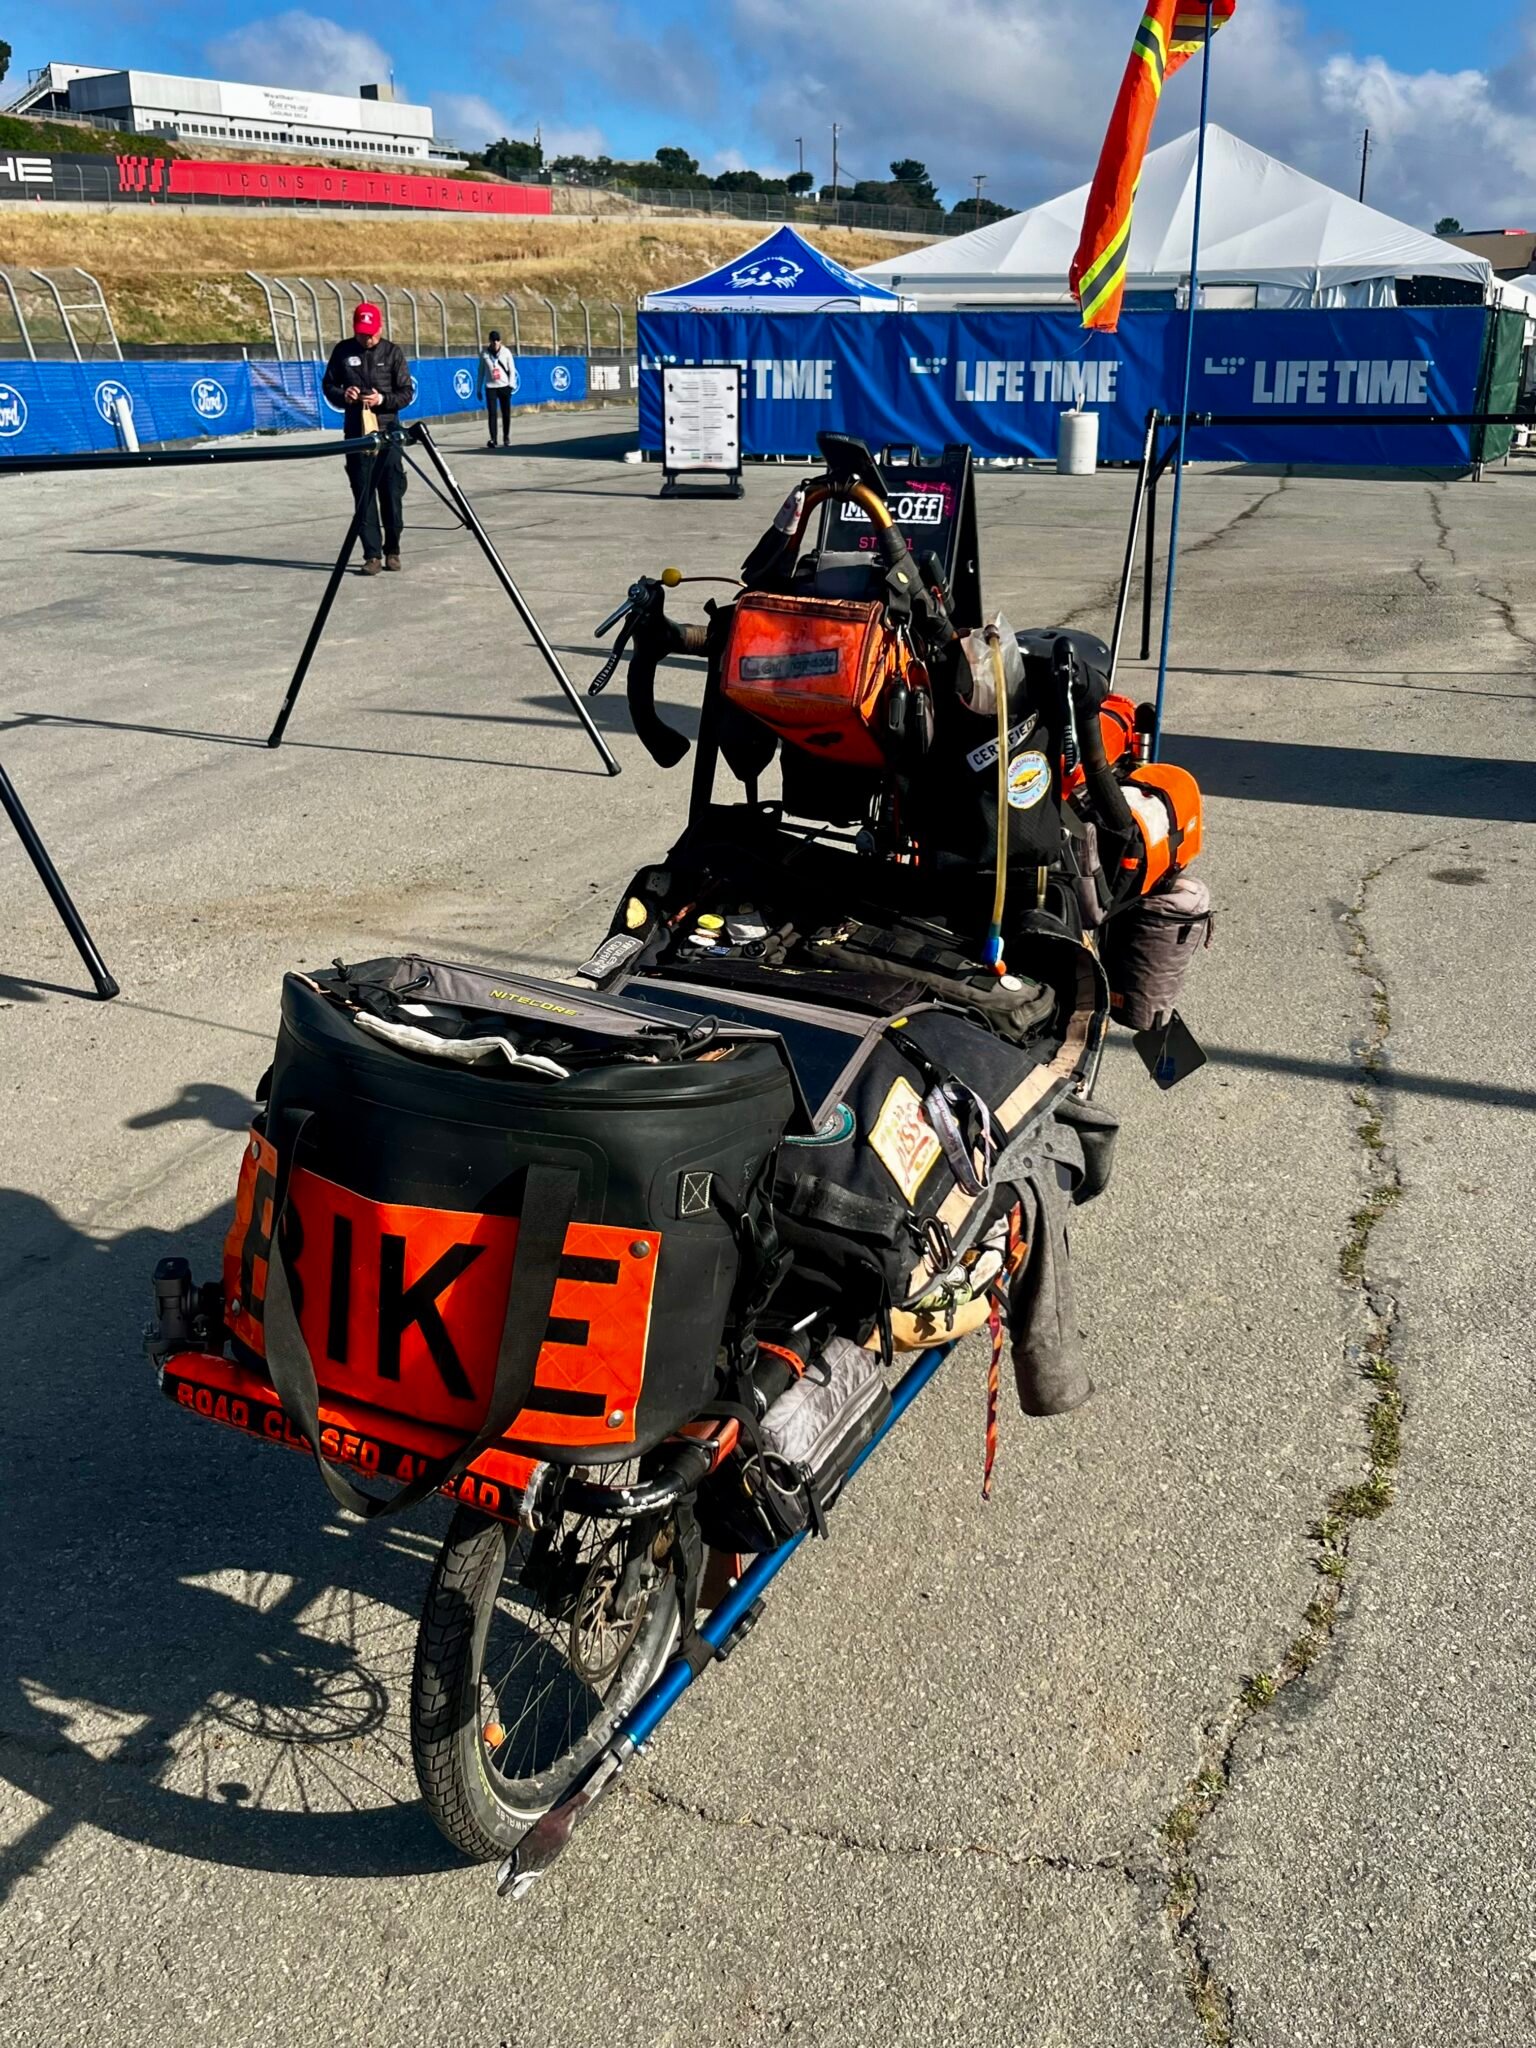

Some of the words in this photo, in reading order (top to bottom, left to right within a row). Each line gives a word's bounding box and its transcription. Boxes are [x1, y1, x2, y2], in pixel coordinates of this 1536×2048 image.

[225, 172, 305, 190] ICONS
[323, 177, 348, 192] OF
[367, 180, 408, 198] THE
[425, 185, 495, 205] TRACK
[197, 383, 224, 412] Ford
[751, 359, 833, 400] TIME
[955, 360, 1025, 402] LIFE
[1030, 360, 1118, 402] TIME
[1252, 360, 1329, 404] LIFE
[1333, 360, 1429, 404] TIME
[845, 496, 939, 520] M-Off
[972, 718, 1034, 767] CERFIED
[489, 989, 578, 1017] NITECORE
[177, 1382, 249, 1427] ROAD
[263, 1409, 380, 1472] CLSED
[495, 1804, 534, 1832] CHWALBE
